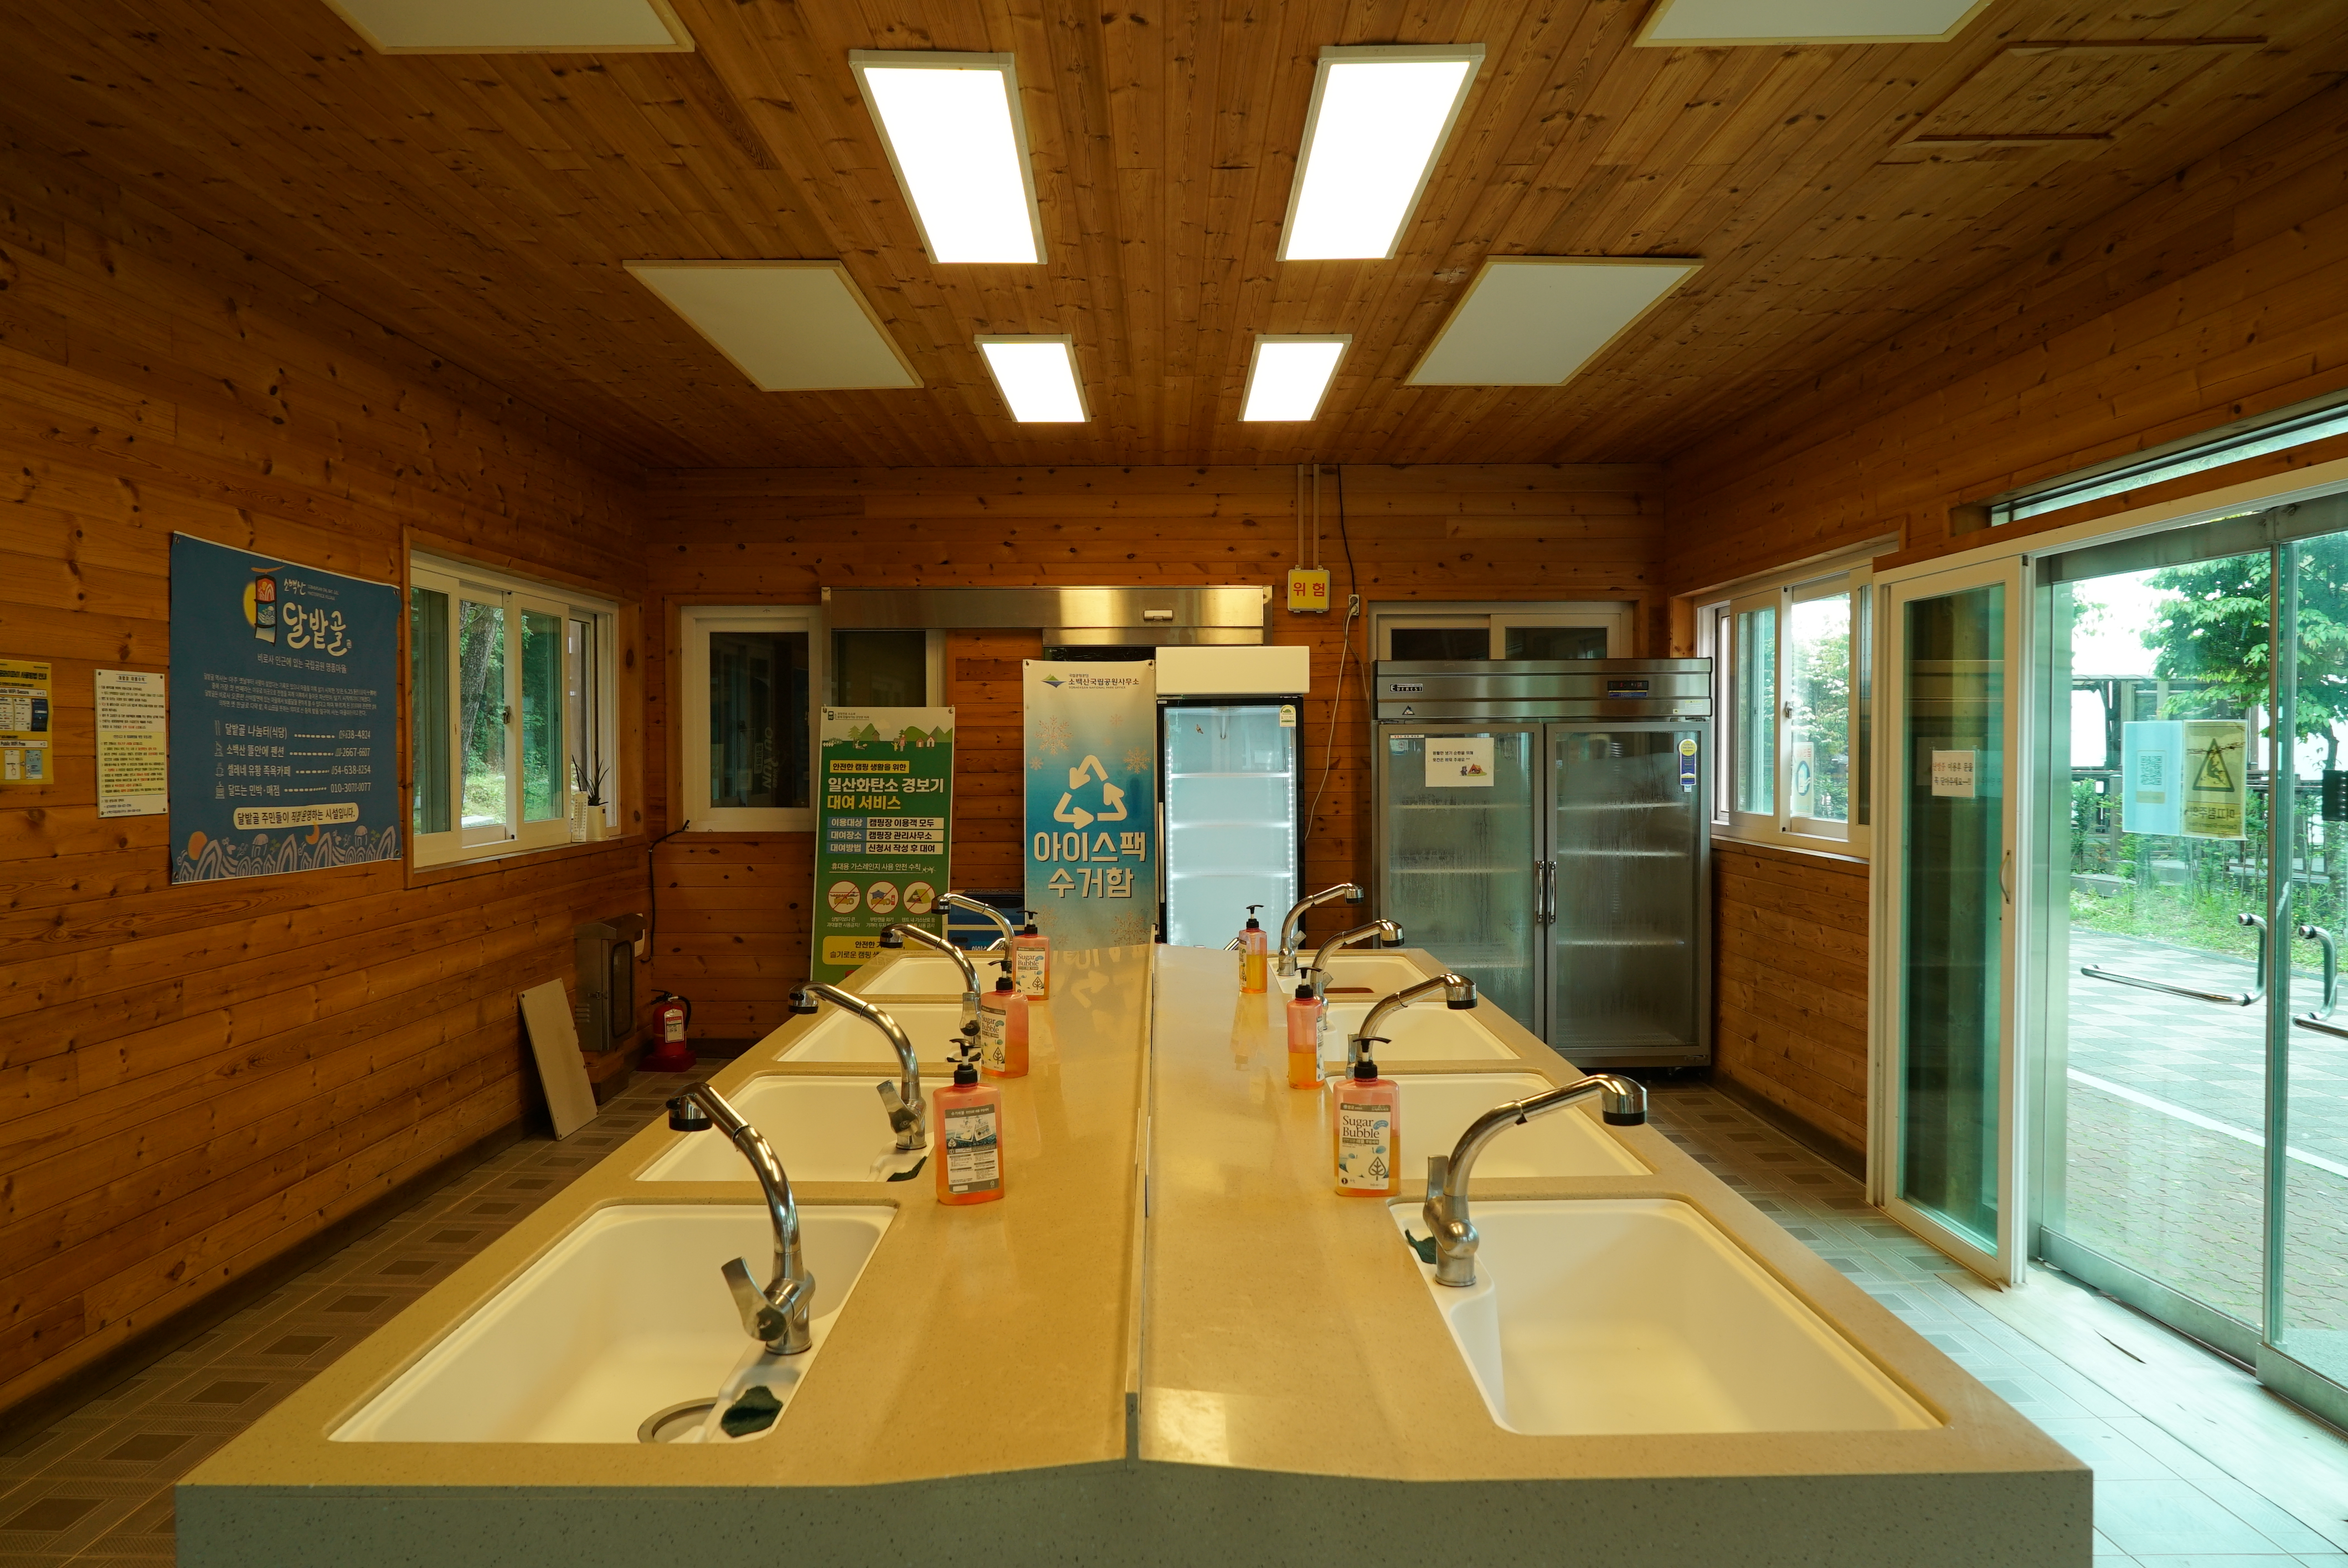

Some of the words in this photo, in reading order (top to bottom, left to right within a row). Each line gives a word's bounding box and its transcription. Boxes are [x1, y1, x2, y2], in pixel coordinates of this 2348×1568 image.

[284, 578, 306, 595] 소백산
[283, 602, 348, 657] 달밭골
[258, 653, 275, 664] 비로사
[275, 656, 292, 667] 인근에
[293, 658, 304, 669] 있는
[305, 659, 326, 672] 국립공원
[326, 663, 348, 674] 명품마을
[1068, 678, 1139, 686] 소백산국립공원사무소
[225, 723, 246, 737] 달밭골
[248, 724, 287, 740] 나눔터(식당)
[226, 742, 246, 756] 소백산
[270, 744, 285, 759] 펜션
[248, 764, 261, 777] 유황
[262, 765, 291, 778] 족욕카페
[828, 777, 899, 793] 일산화탄소
[901, 778, 944, 793] 경보기
[827, 795, 856, 810] 대여
[858, 795, 902, 810] 서비스
[237, 811, 260, 826] 달밭골
[261, 810, 290, 825] 주민들이
[325, 806, 355, 821] 시설입니다.
[831, 818, 863, 828] 이용대상
[869, 819, 893, 828] 캠핑장
[894, 819, 918, 828] 이용객
[919, 819, 935, 828] 모두
[830, 831, 862, 840] 대여장소
[868, 831, 892, 840] 캠핑장
[893, 832, 933, 840] 관리사무소
[830, 843, 862, 853] 대여방법
[868, 843, 891, 853] 신청서
[893, 844, 909, 853] 작성
[910, 844, 919, 853] 후
[920, 844, 936, 853] 대여
[1034, 832, 1146, 862] 아이스팩
[831, 863, 849, 871] 휴대용
[850, 863, 881, 871] 가스레인지
[881, 863, 894, 871] 사용
[895, 863, 908, 871] 안전
[909, 864, 921, 872] 수칙
[1048, 867, 1135, 898] 수거함
[1343, 1115, 1374, 1128] Sugar
[1343, 1127, 1379, 1139] Bubble
